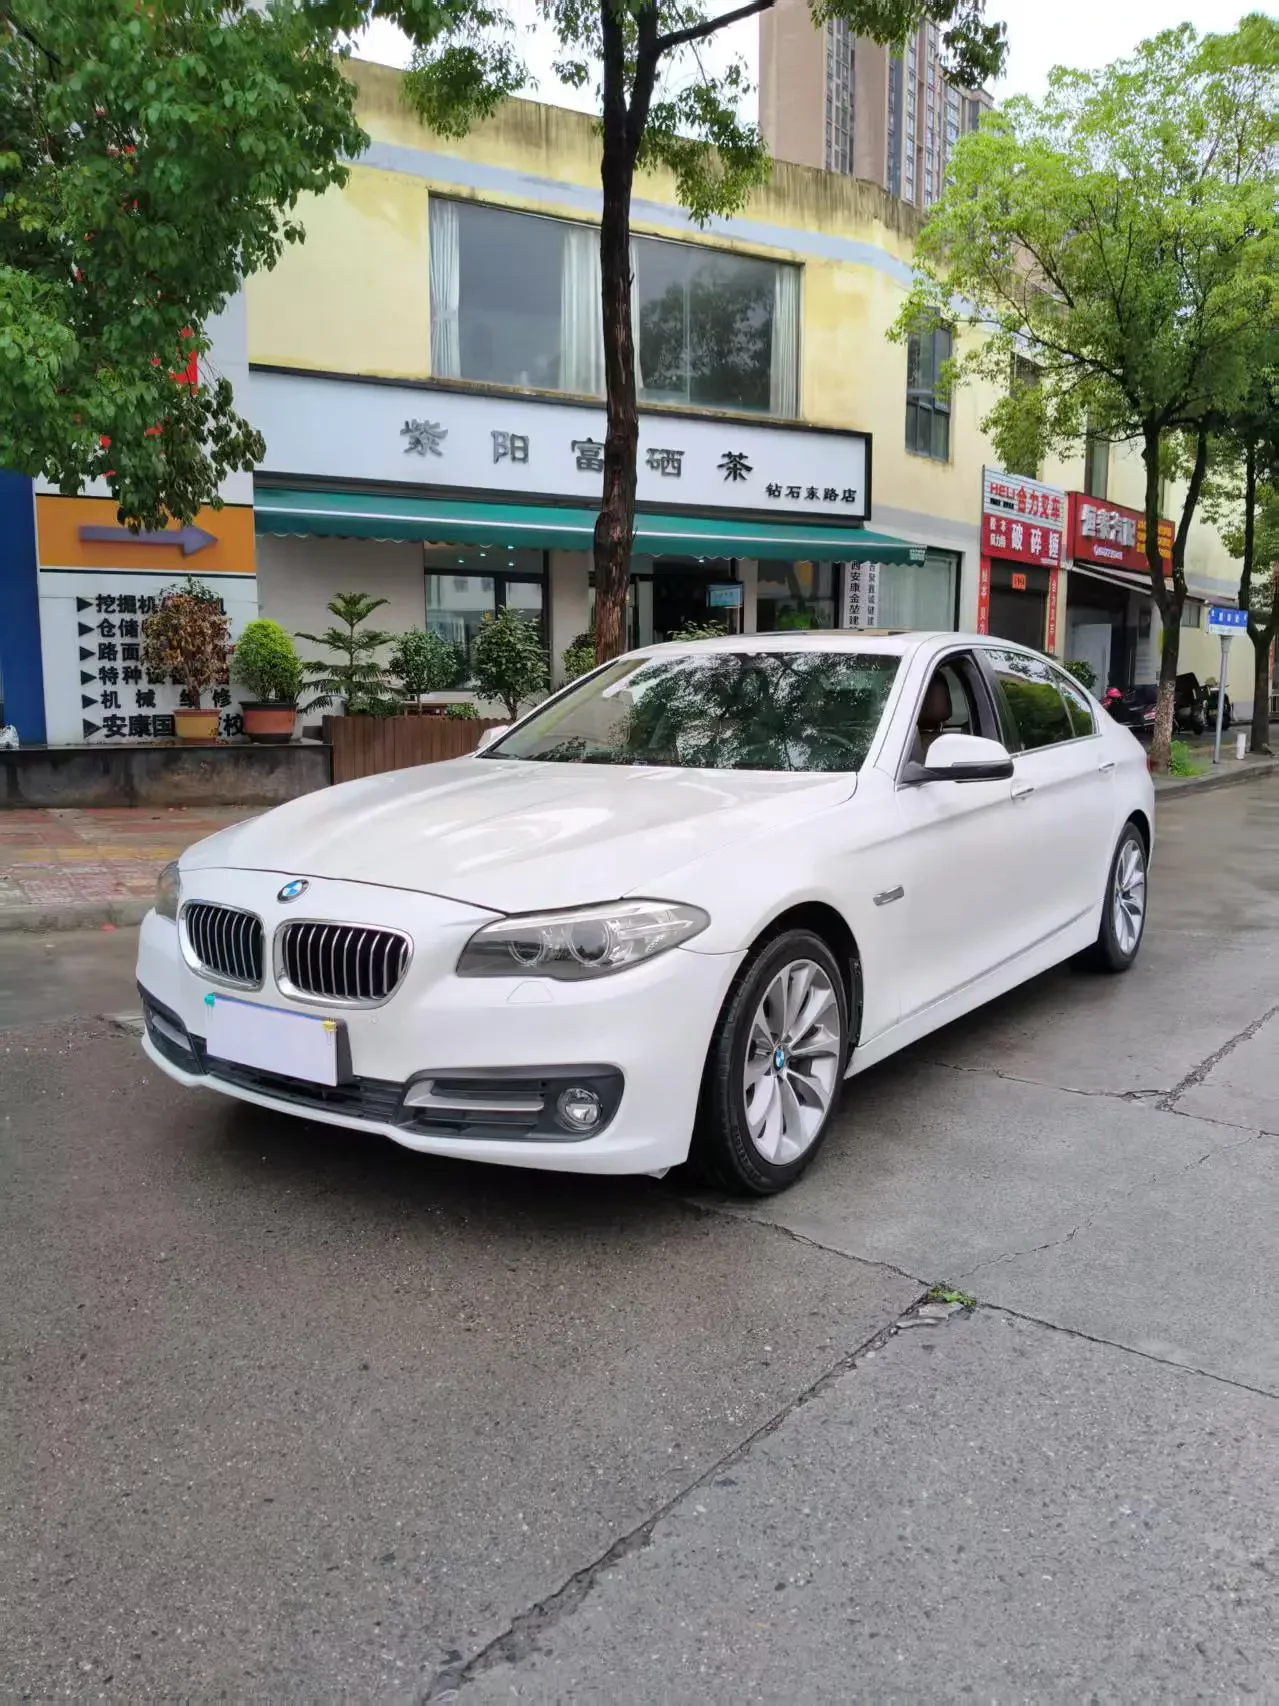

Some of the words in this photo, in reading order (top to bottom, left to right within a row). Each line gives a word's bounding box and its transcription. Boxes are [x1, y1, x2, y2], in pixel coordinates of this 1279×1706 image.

[400, 418, 753, 482] 紫阳富硒茶
[765, 483, 857, 503] 钻石东路店
[849, 561, 861, 629] 西安康金堃建
[103, 714, 244, 738] 安康国校
